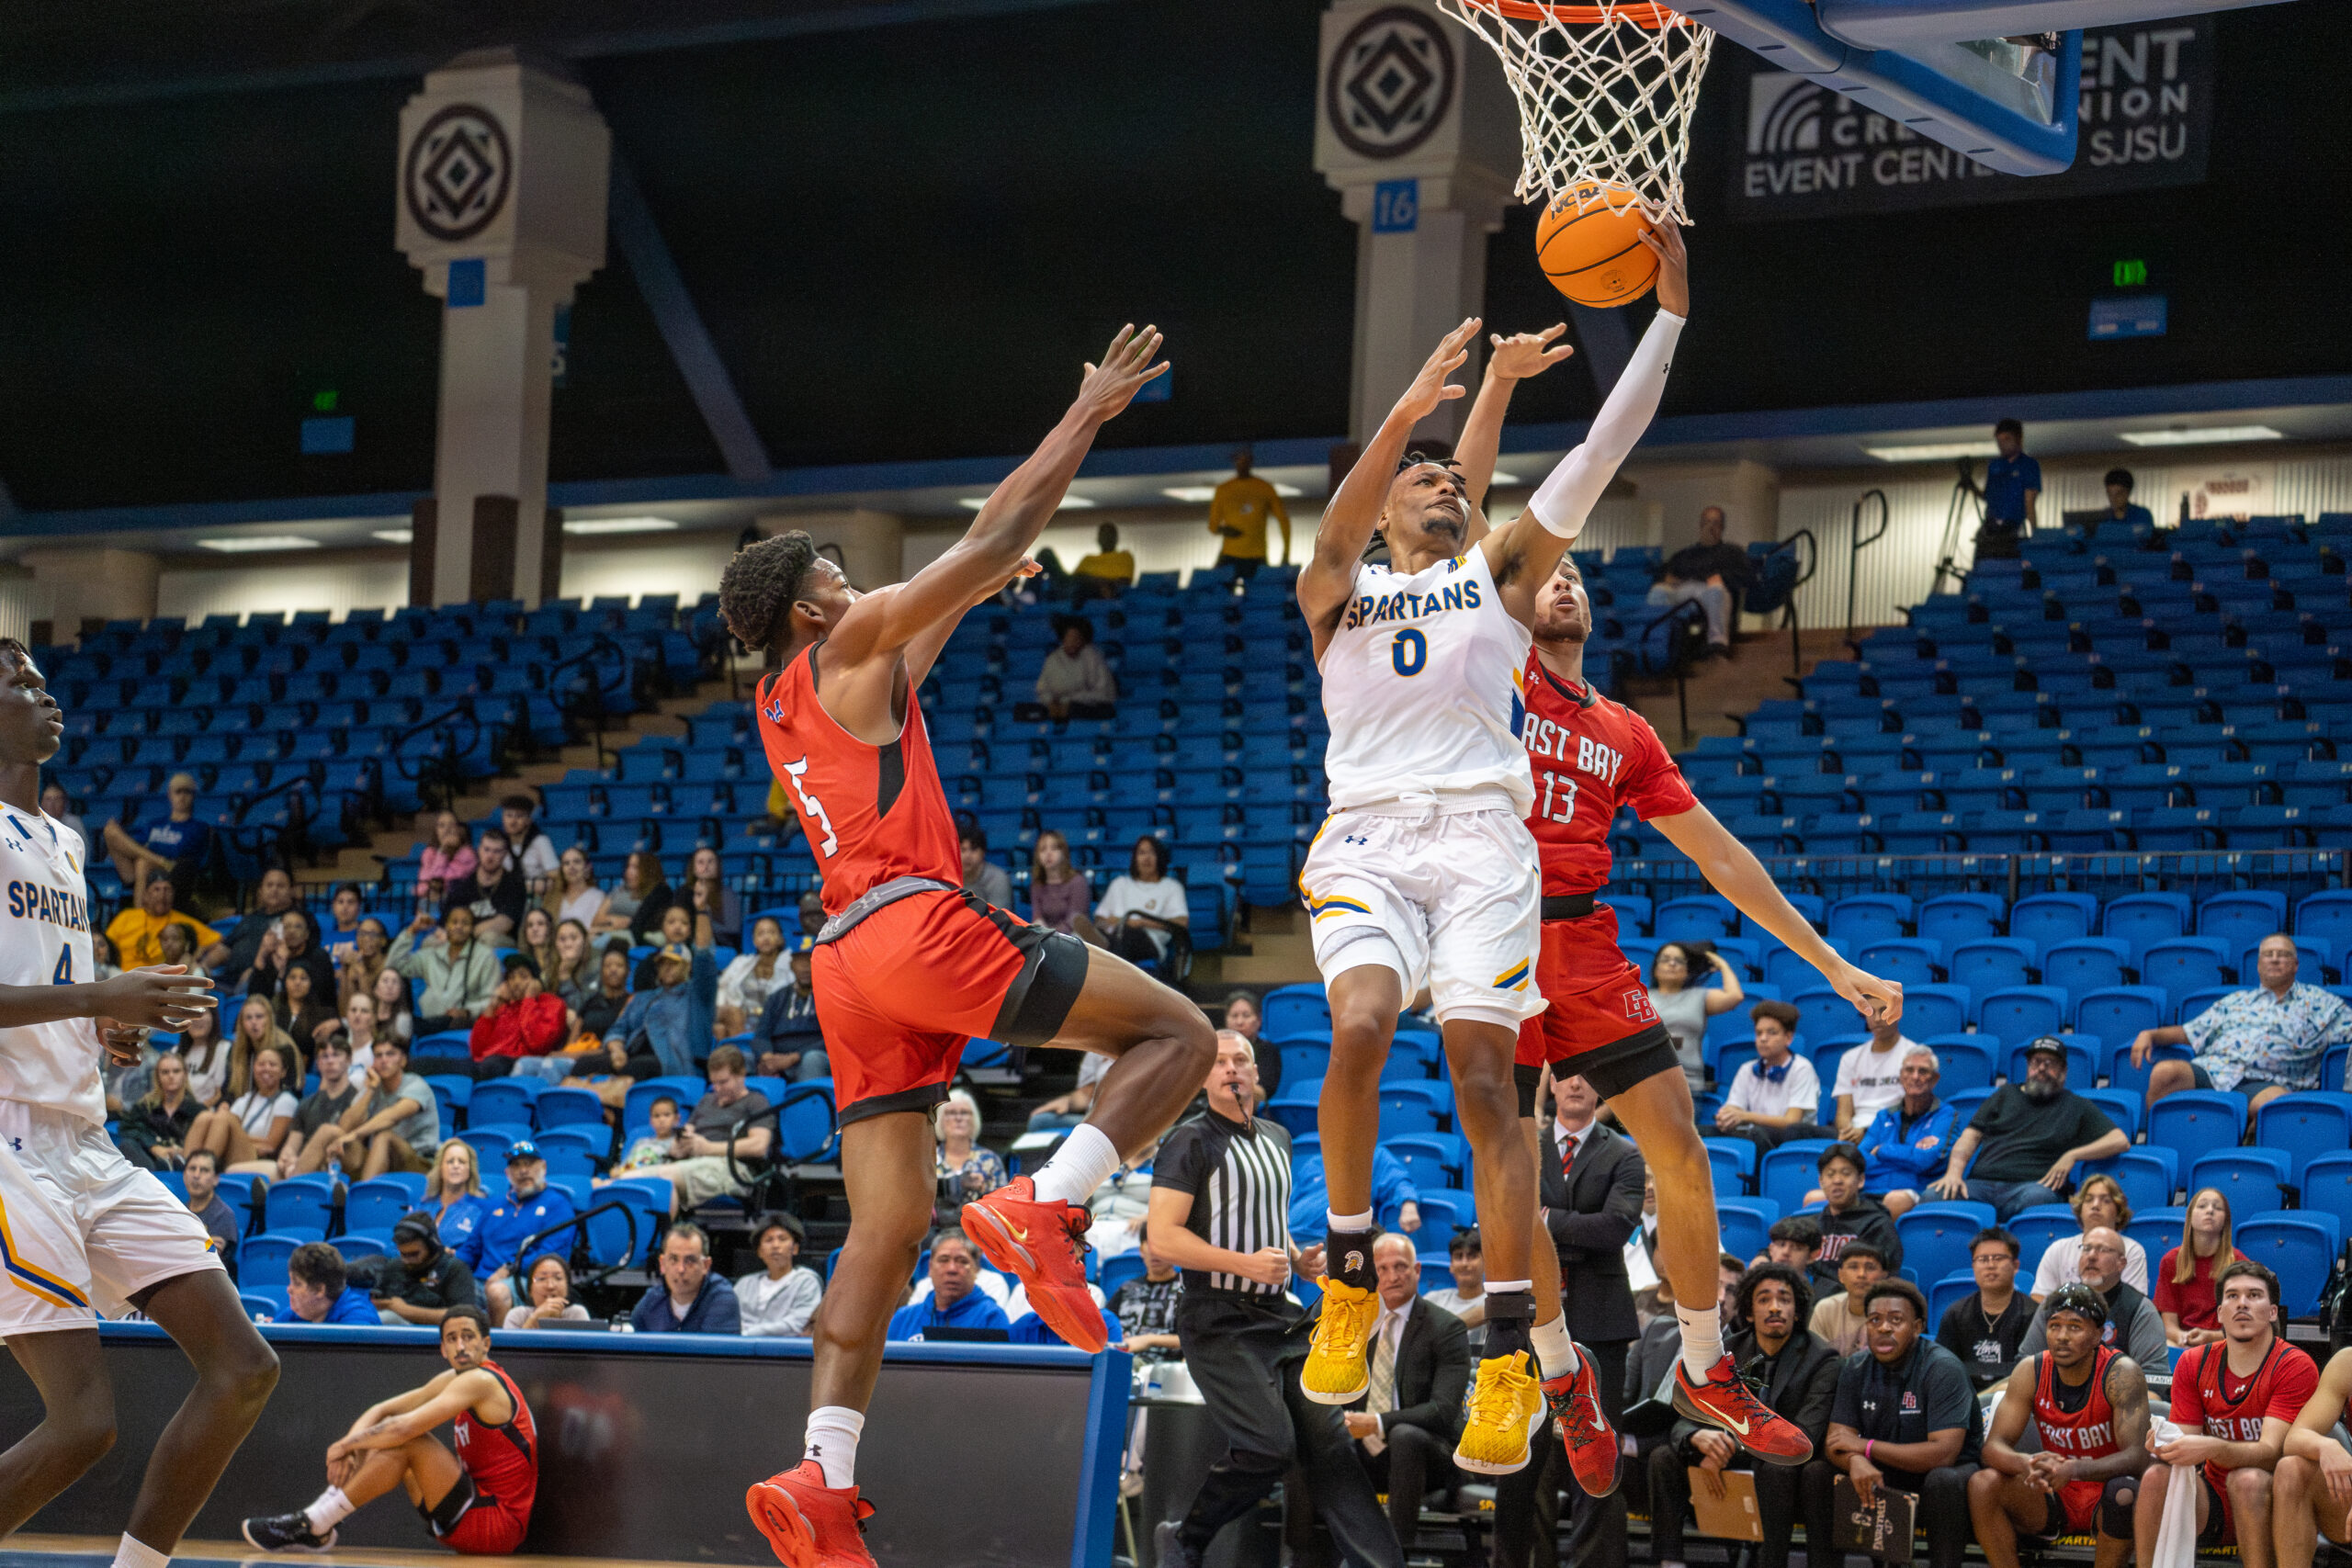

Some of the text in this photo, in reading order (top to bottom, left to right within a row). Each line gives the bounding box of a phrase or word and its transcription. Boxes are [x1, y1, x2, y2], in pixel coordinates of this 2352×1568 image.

[1746, 153, 1866, 197] EVENT
[2089, 122, 2188, 167] SJSU
[1380, 190, 1413, 225] 16
[1346, 579, 1482, 631] SPARTANS
[1391, 626, 1428, 678] 0
[1577, 736, 1623, 787] BAY
[782, 753, 839, 860] 5
[1542, 770, 1578, 824] 13
[7, 880, 90, 934] SPARTAN
[52, 942, 75, 986] 4
[2077, 1420, 2112, 1450] BAY
[2206, 1416, 2235, 1440] AST
